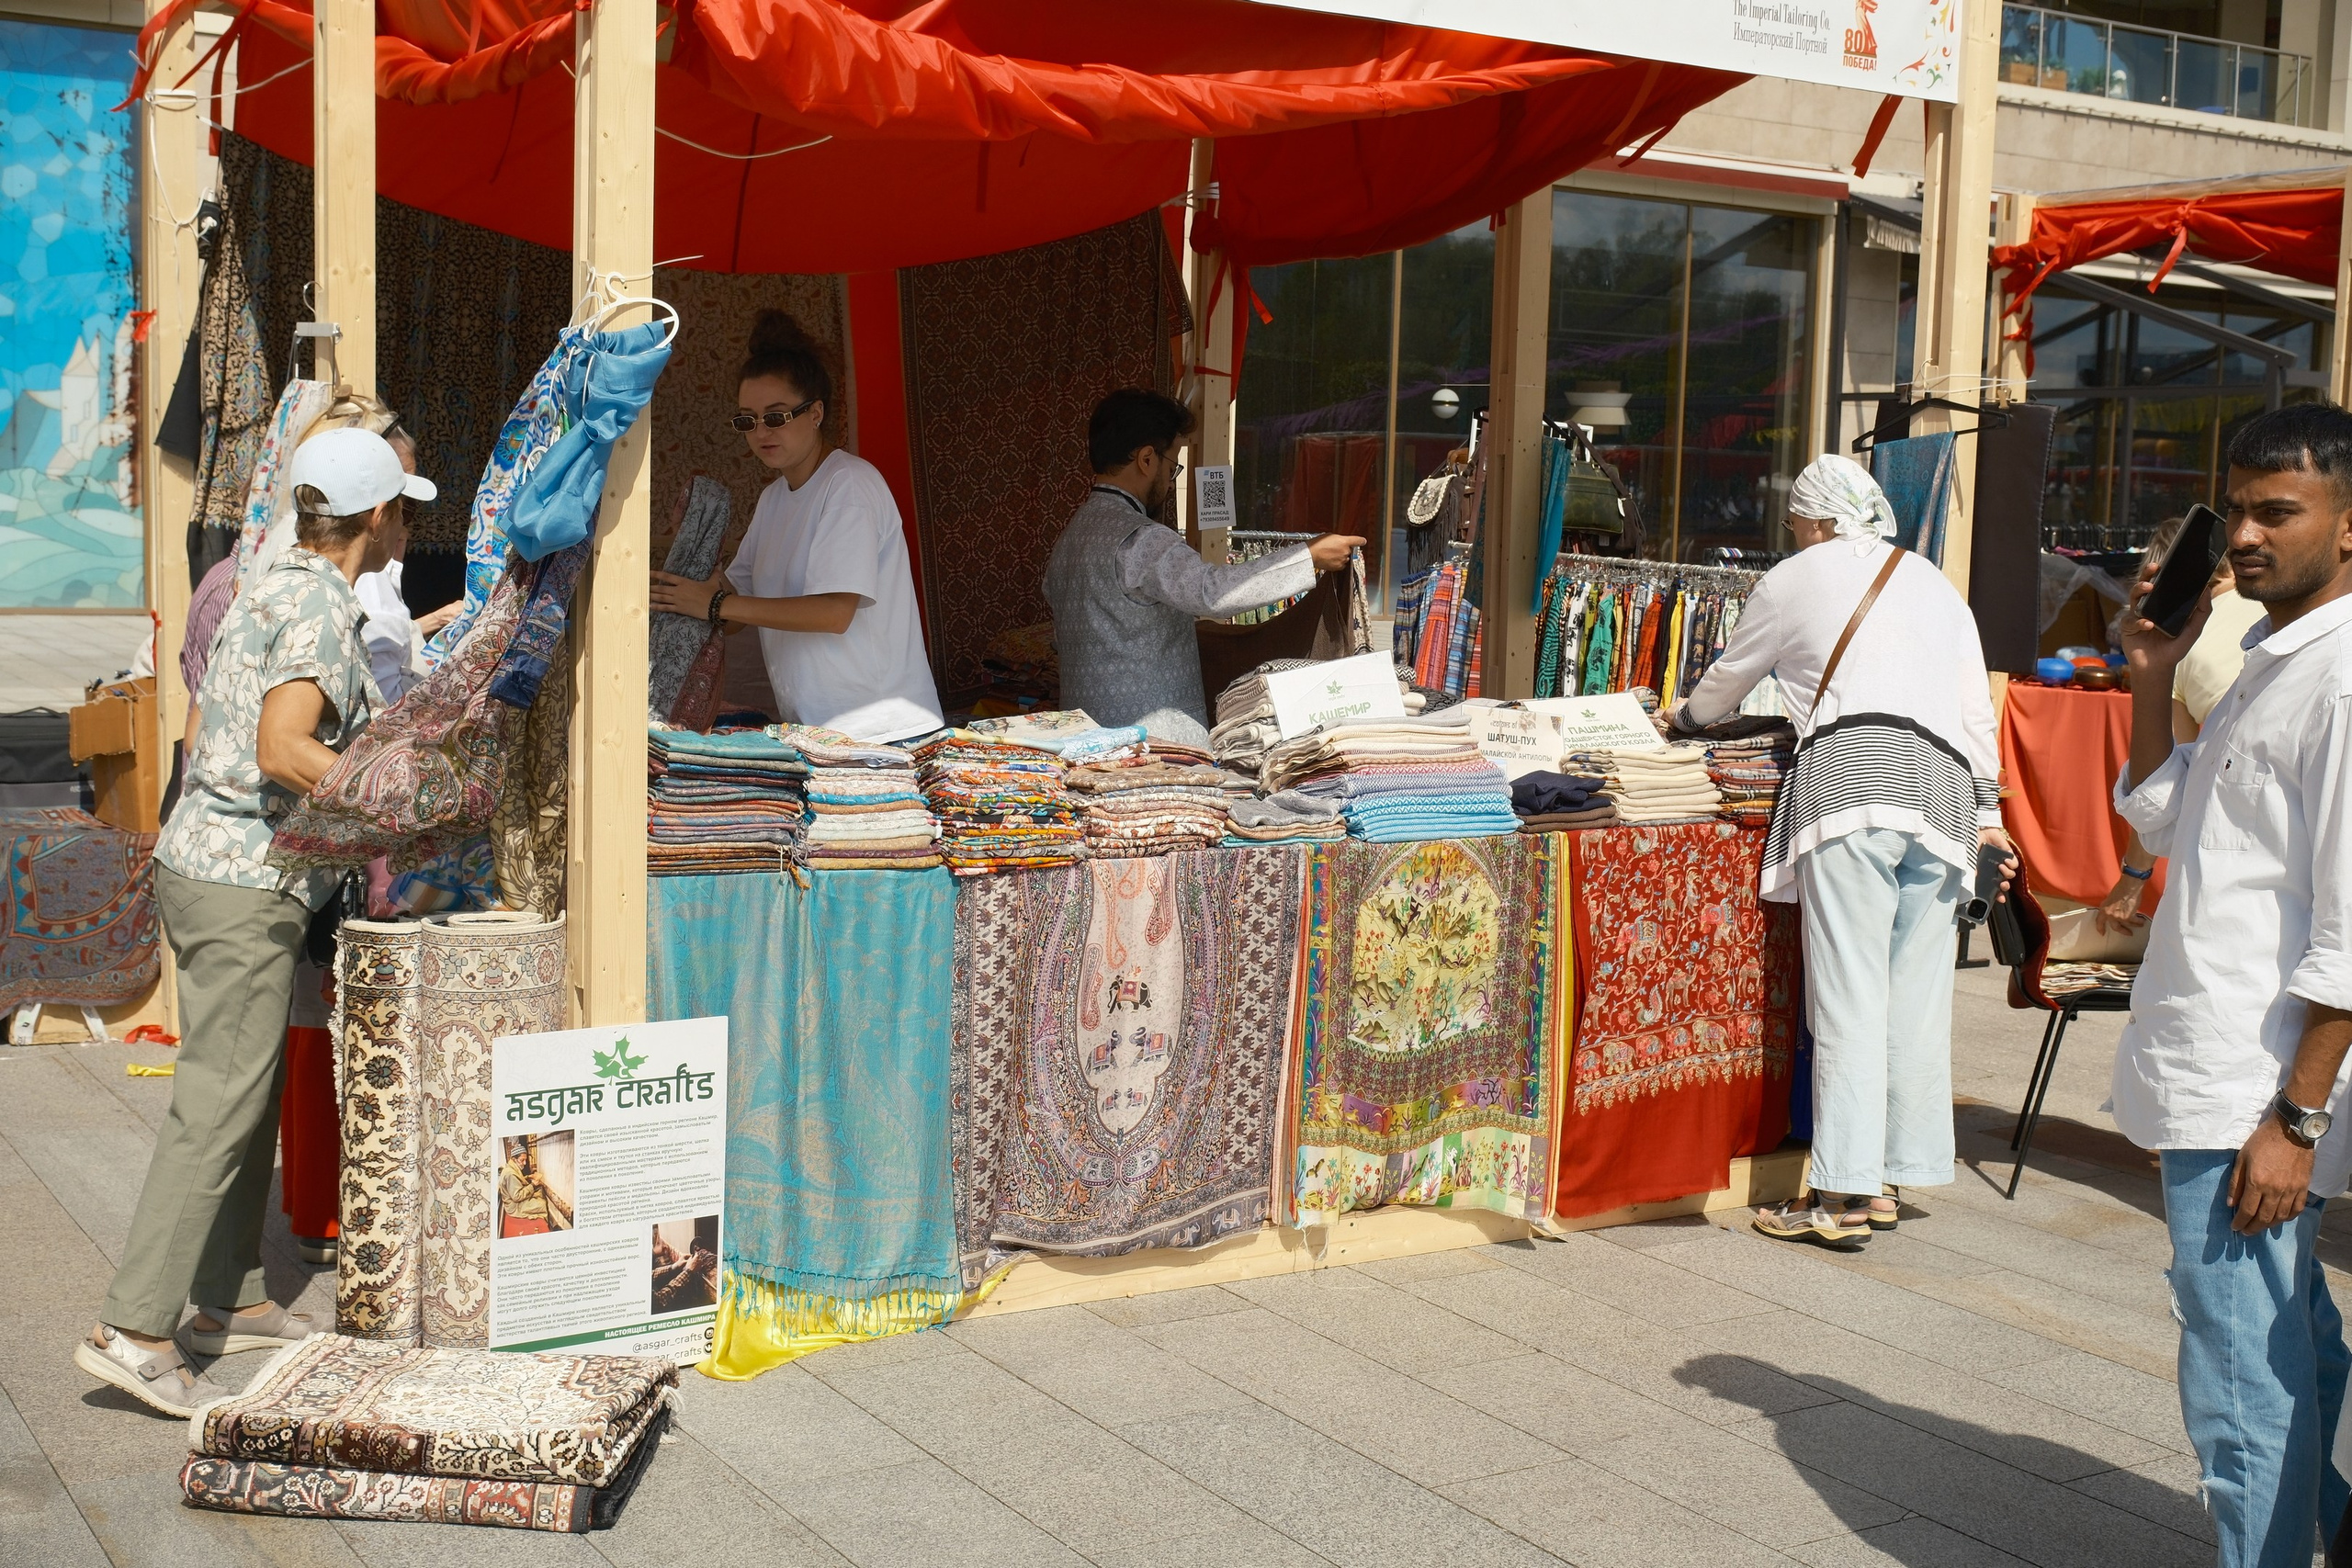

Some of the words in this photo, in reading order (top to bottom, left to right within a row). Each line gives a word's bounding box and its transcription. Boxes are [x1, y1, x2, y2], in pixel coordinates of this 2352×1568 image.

[1733, 0, 1747, 17] The
[1748, 0, 1781, 26] Imperial
[1783, 4, 1818, 35] Tailoring
[1820, 9, 1830, 30] Co.
[1734, 21, 1793, 50] Императорский
[1795, 31, 1828, 55] Портной
[1844, 28, 1863, 52] 80
[1843, 55, 1877, 72] ПОБЕДА!
[1210, 471, 1224, 479] ВТБ
[1308, 701, 1372, 725] КАШЕМИР
[1564, 734, 1613, 743] ОДШЕРСТОК
[1615, 731, 1651, 739] ГОРНОГО
[1567, 723, 1630, 735] ПАШМИНА
[1487, 732, 1537, 746] ШАТУШ-ПУХ
[1480, 749, 1517, 759] МАЛАЙСКОЙ
[1518, 753, 1553, 762] АНТИЛОПЫ
[605, 1325, 648, 1338] НАСТОЯЩЕЕ
[648, 1320, 681, 1331] РЕМЕСЛО
[681, 1314, 716, 1325] КАШМИРА
[632, 1332, 703, 1354] @asgar_crafts
